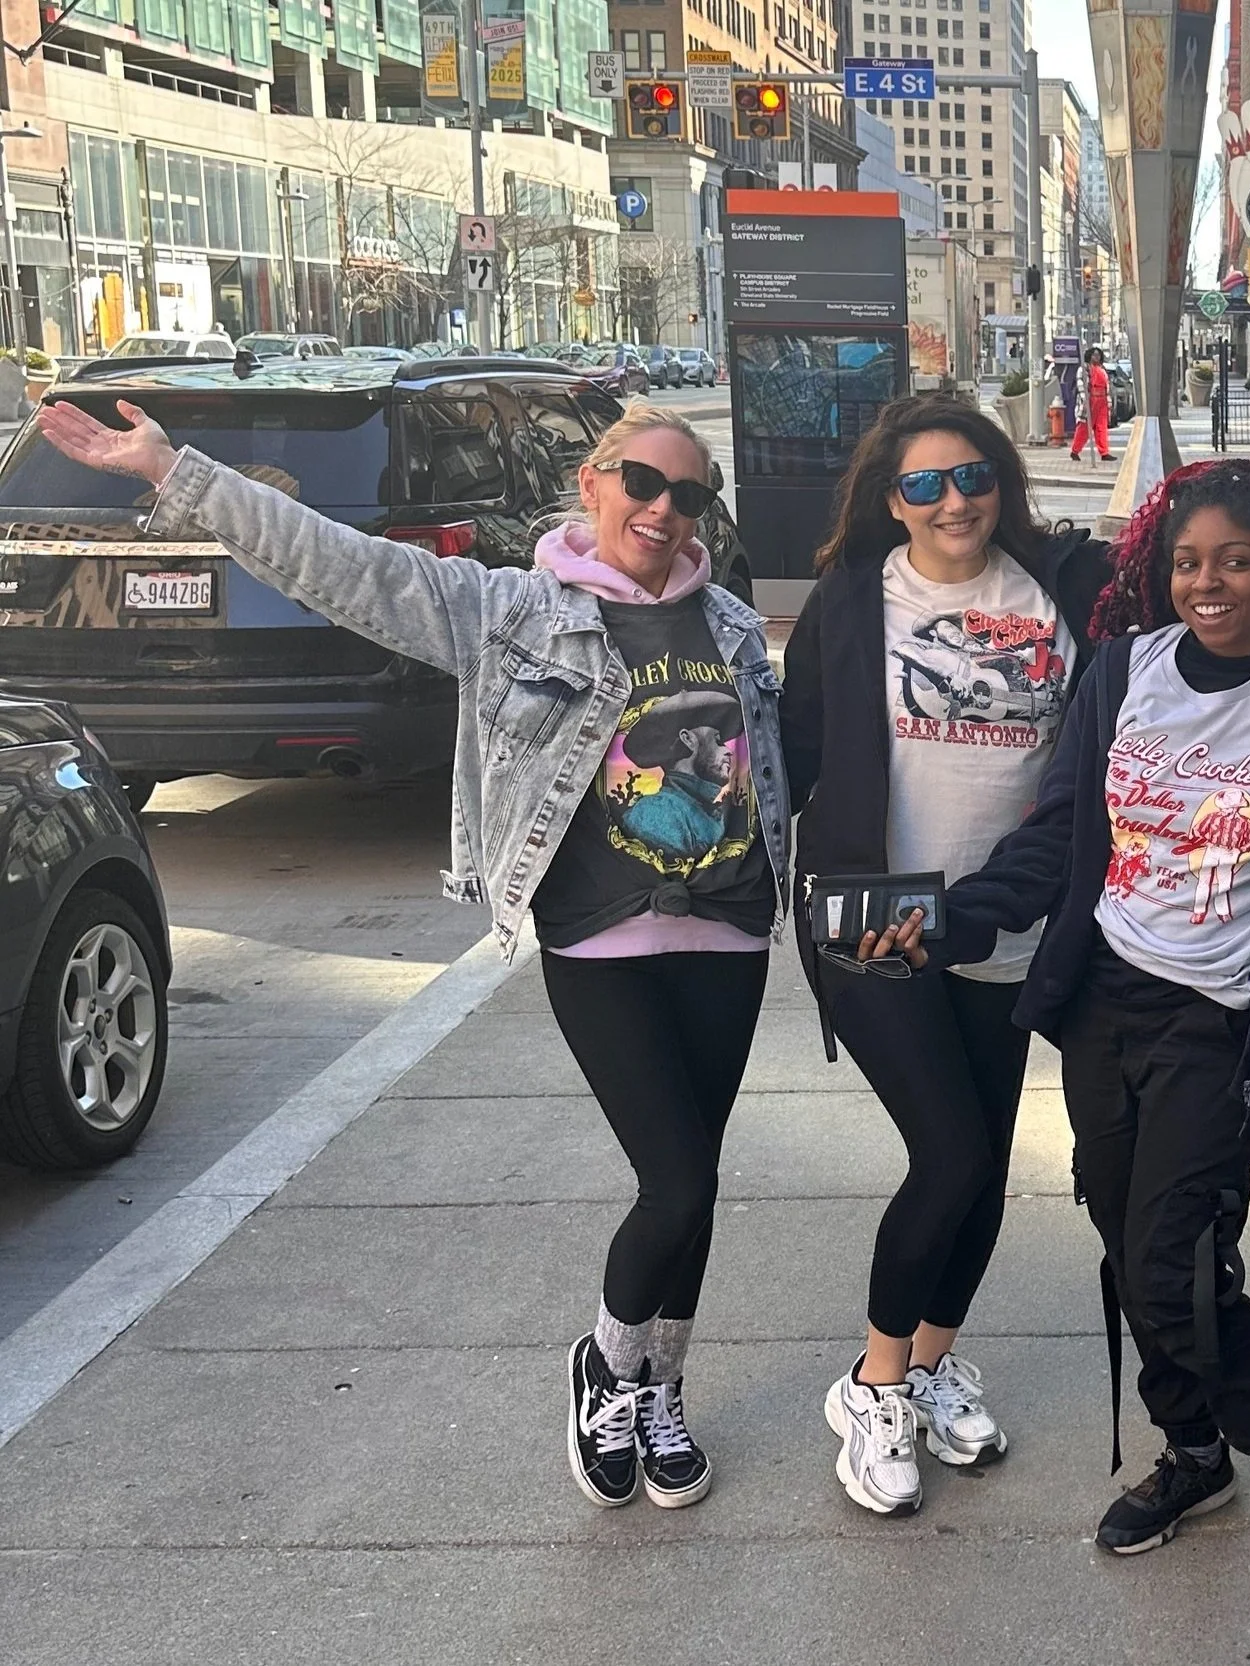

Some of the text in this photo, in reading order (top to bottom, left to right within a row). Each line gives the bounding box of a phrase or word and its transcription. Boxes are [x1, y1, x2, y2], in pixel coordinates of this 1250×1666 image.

[596, 56, 615, 66] BUS
[689, 54, 728, 62] CROSSWALK
[871, 60, 906, 69] Gateway
[490, 69, 521, 82] 2025
[594, 68, 618, 79] ONLY
[690, 67, 704, 75] STOP
[855, 73, 926, 94] E. 4 St
[626, 194, 640, 213] P
[754, 223, 781, 232] Avenue
[731, 232, 805, 241] GATEWAY DISTRICT
[914, 266, 929, 279] to
[148, 582, 210, 605] 944ZBG
[628, 651, 670, 688] LEY
[896, 717, 941, 742] SAN
[943, 721, 1039, 749] ANTONIO
[1124, 780, 1187, 814] Dollar
[1156, 880, 1178, 892] USA
